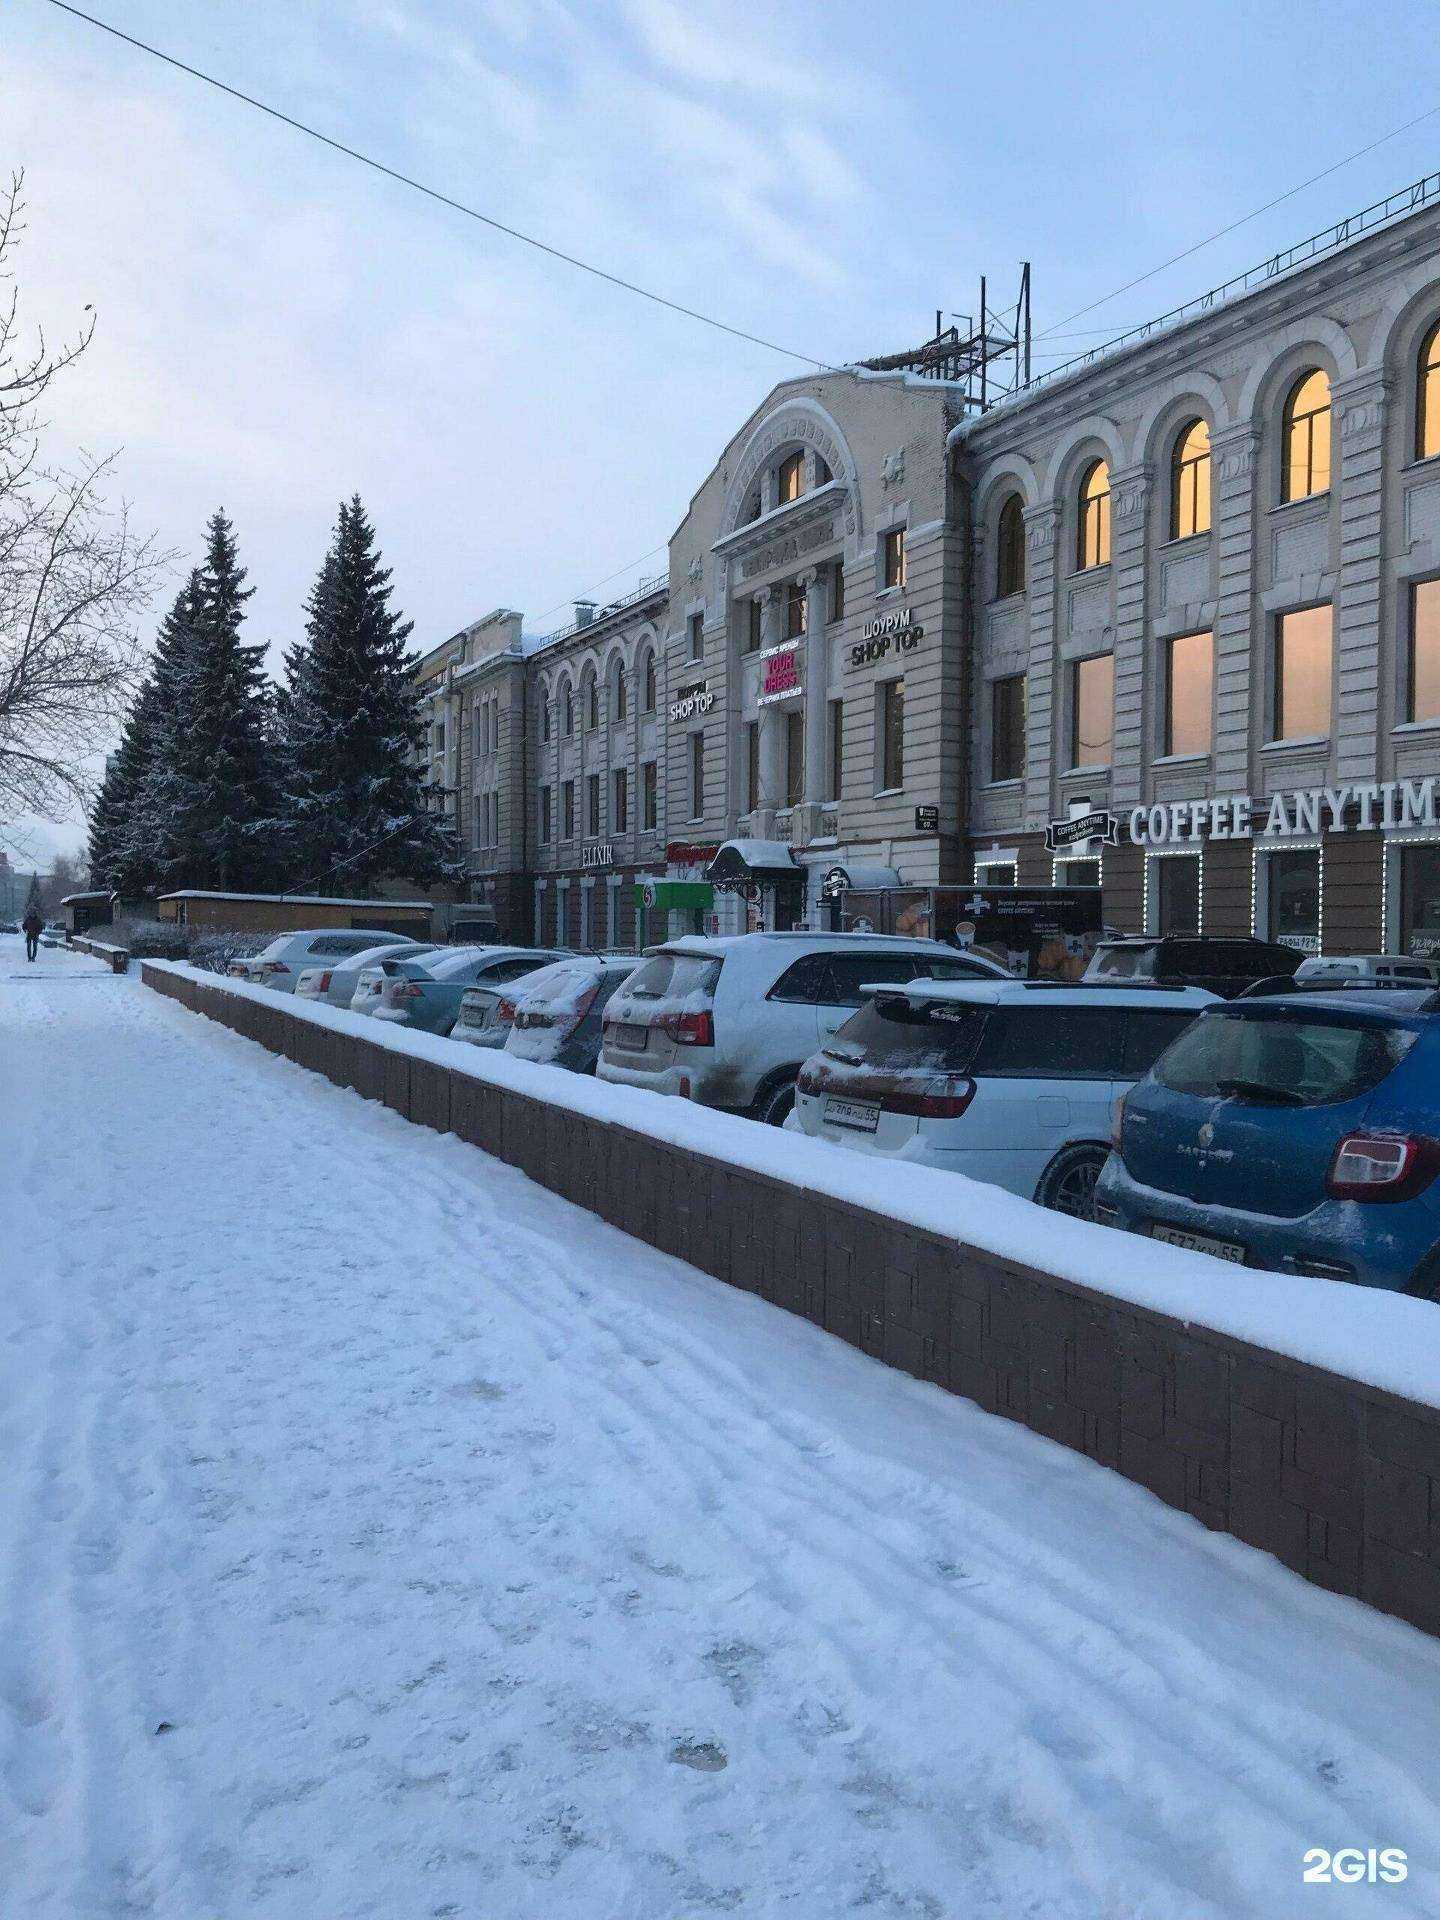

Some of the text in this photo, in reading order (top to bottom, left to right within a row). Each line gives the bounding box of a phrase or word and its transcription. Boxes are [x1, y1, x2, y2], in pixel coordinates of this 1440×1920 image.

[863, 608, 911, 640] ШОУРУМ
[851, 626, 924, 666] SHOP TOP
[670, 692, 713, 721] SHOP TOP
[1057, 823, 1077, 836] COFFEE
[1130, 796, 1251, 846] COFFEE
